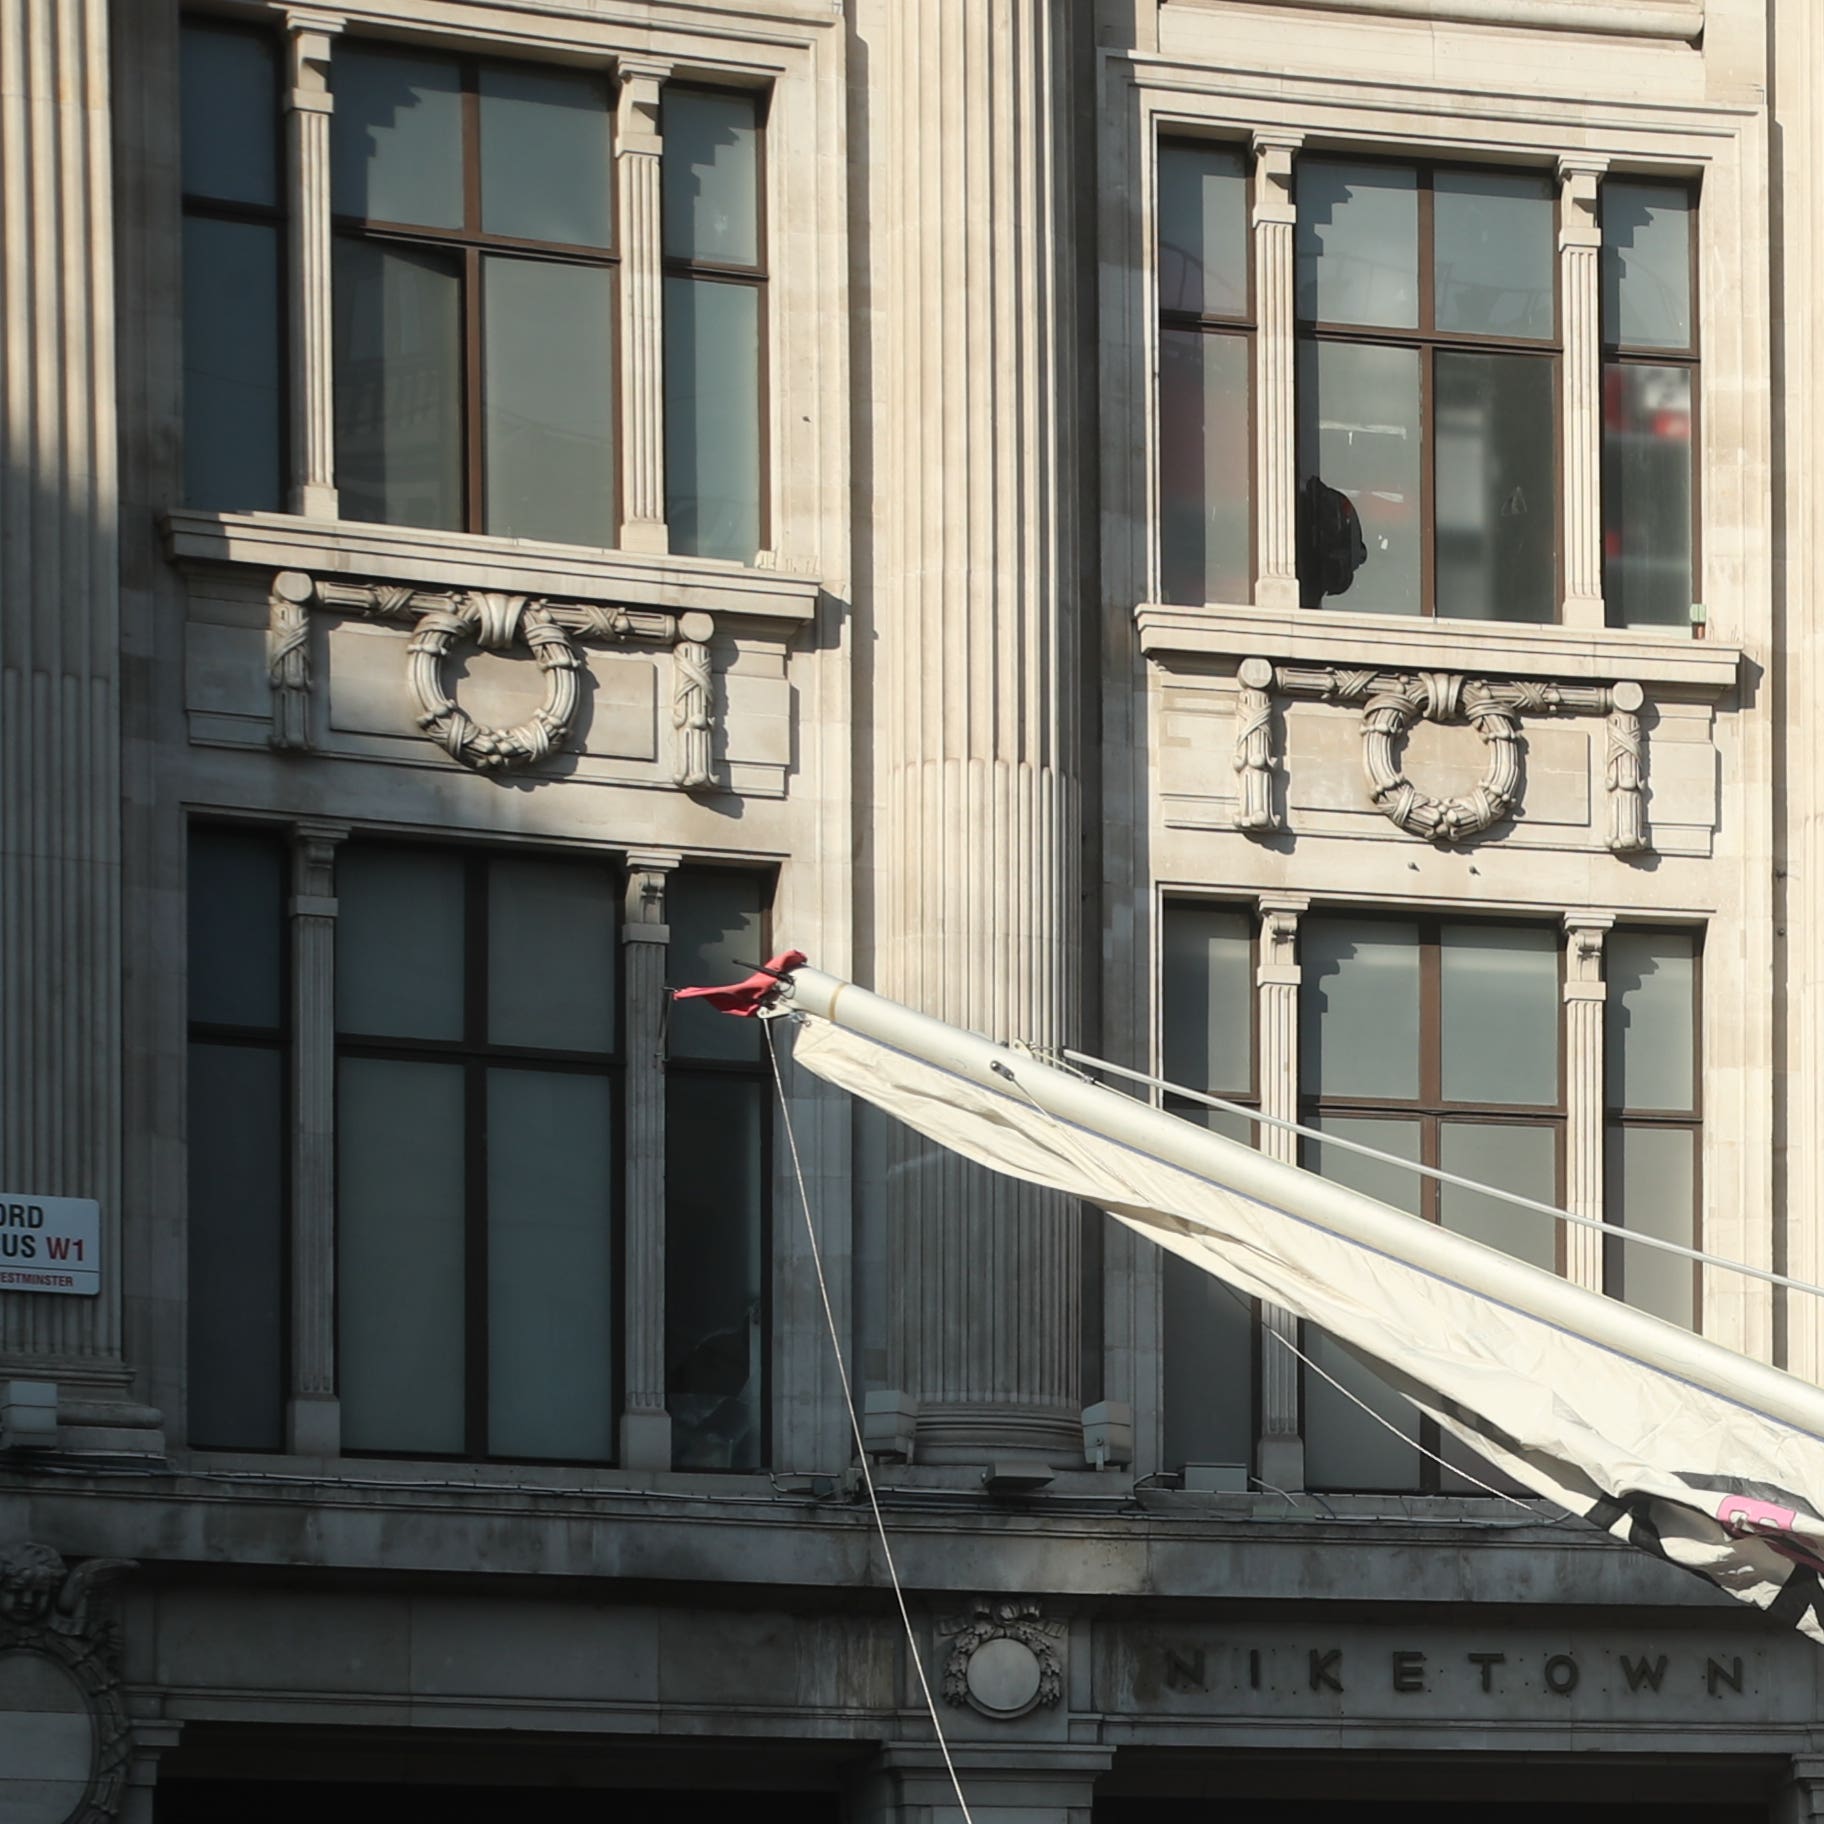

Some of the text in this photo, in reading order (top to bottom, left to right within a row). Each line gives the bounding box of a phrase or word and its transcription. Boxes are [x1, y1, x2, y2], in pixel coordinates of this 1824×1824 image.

[46, 1236, 84, 1261] W1
[0, 1273, 73, 1287] ESTMINSTER
[1165, 1648, 1744, 1696] NIKETOWN
